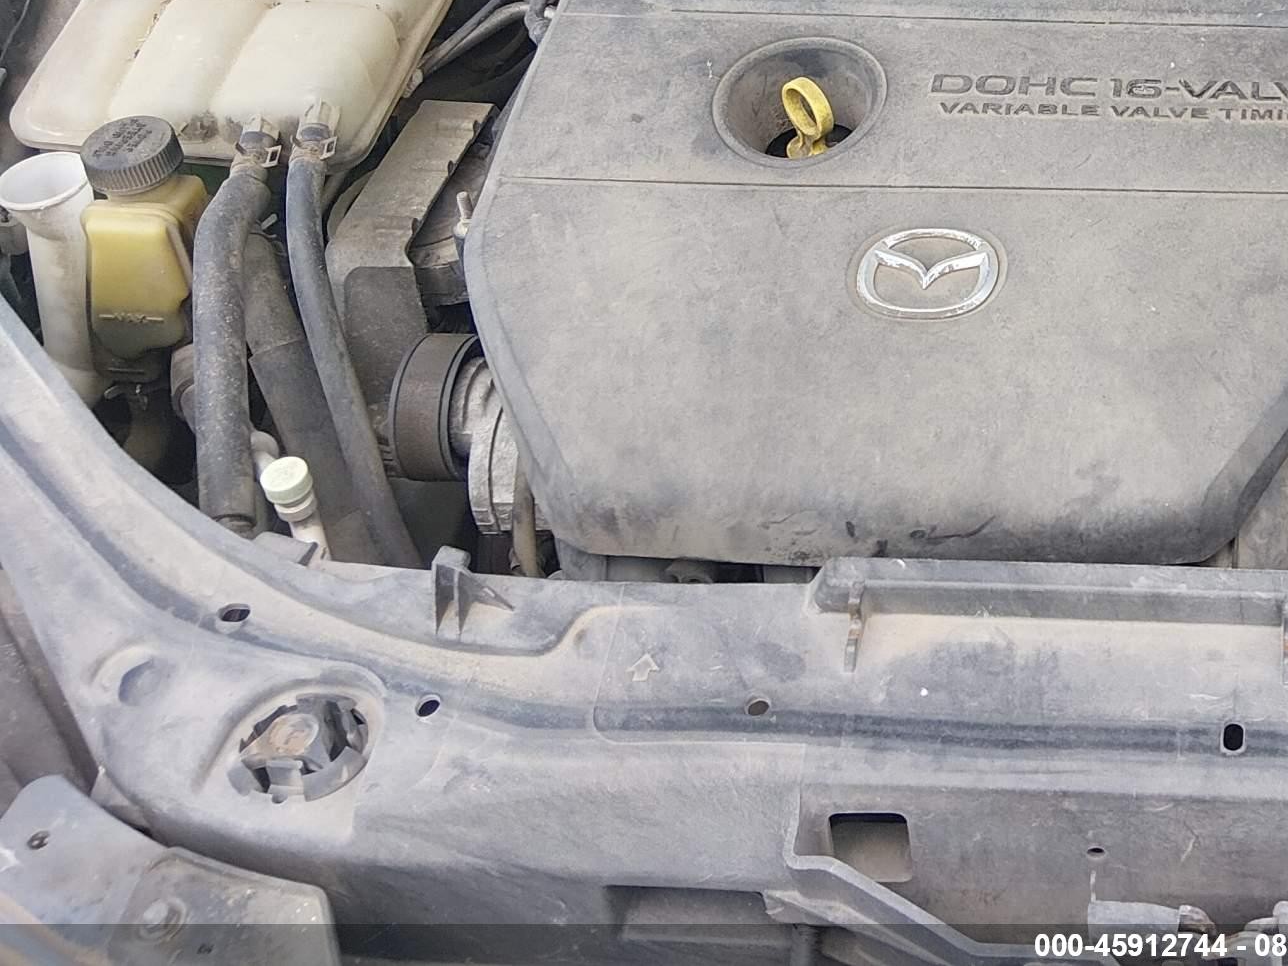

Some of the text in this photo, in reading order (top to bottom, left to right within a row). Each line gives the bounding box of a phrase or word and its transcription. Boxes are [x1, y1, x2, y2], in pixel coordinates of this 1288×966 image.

[930, 74, 1096, 96] DOHC
[940, 102, 1100, 116] VARIABLE
[1111, 106, 1210, 119] VALVE
